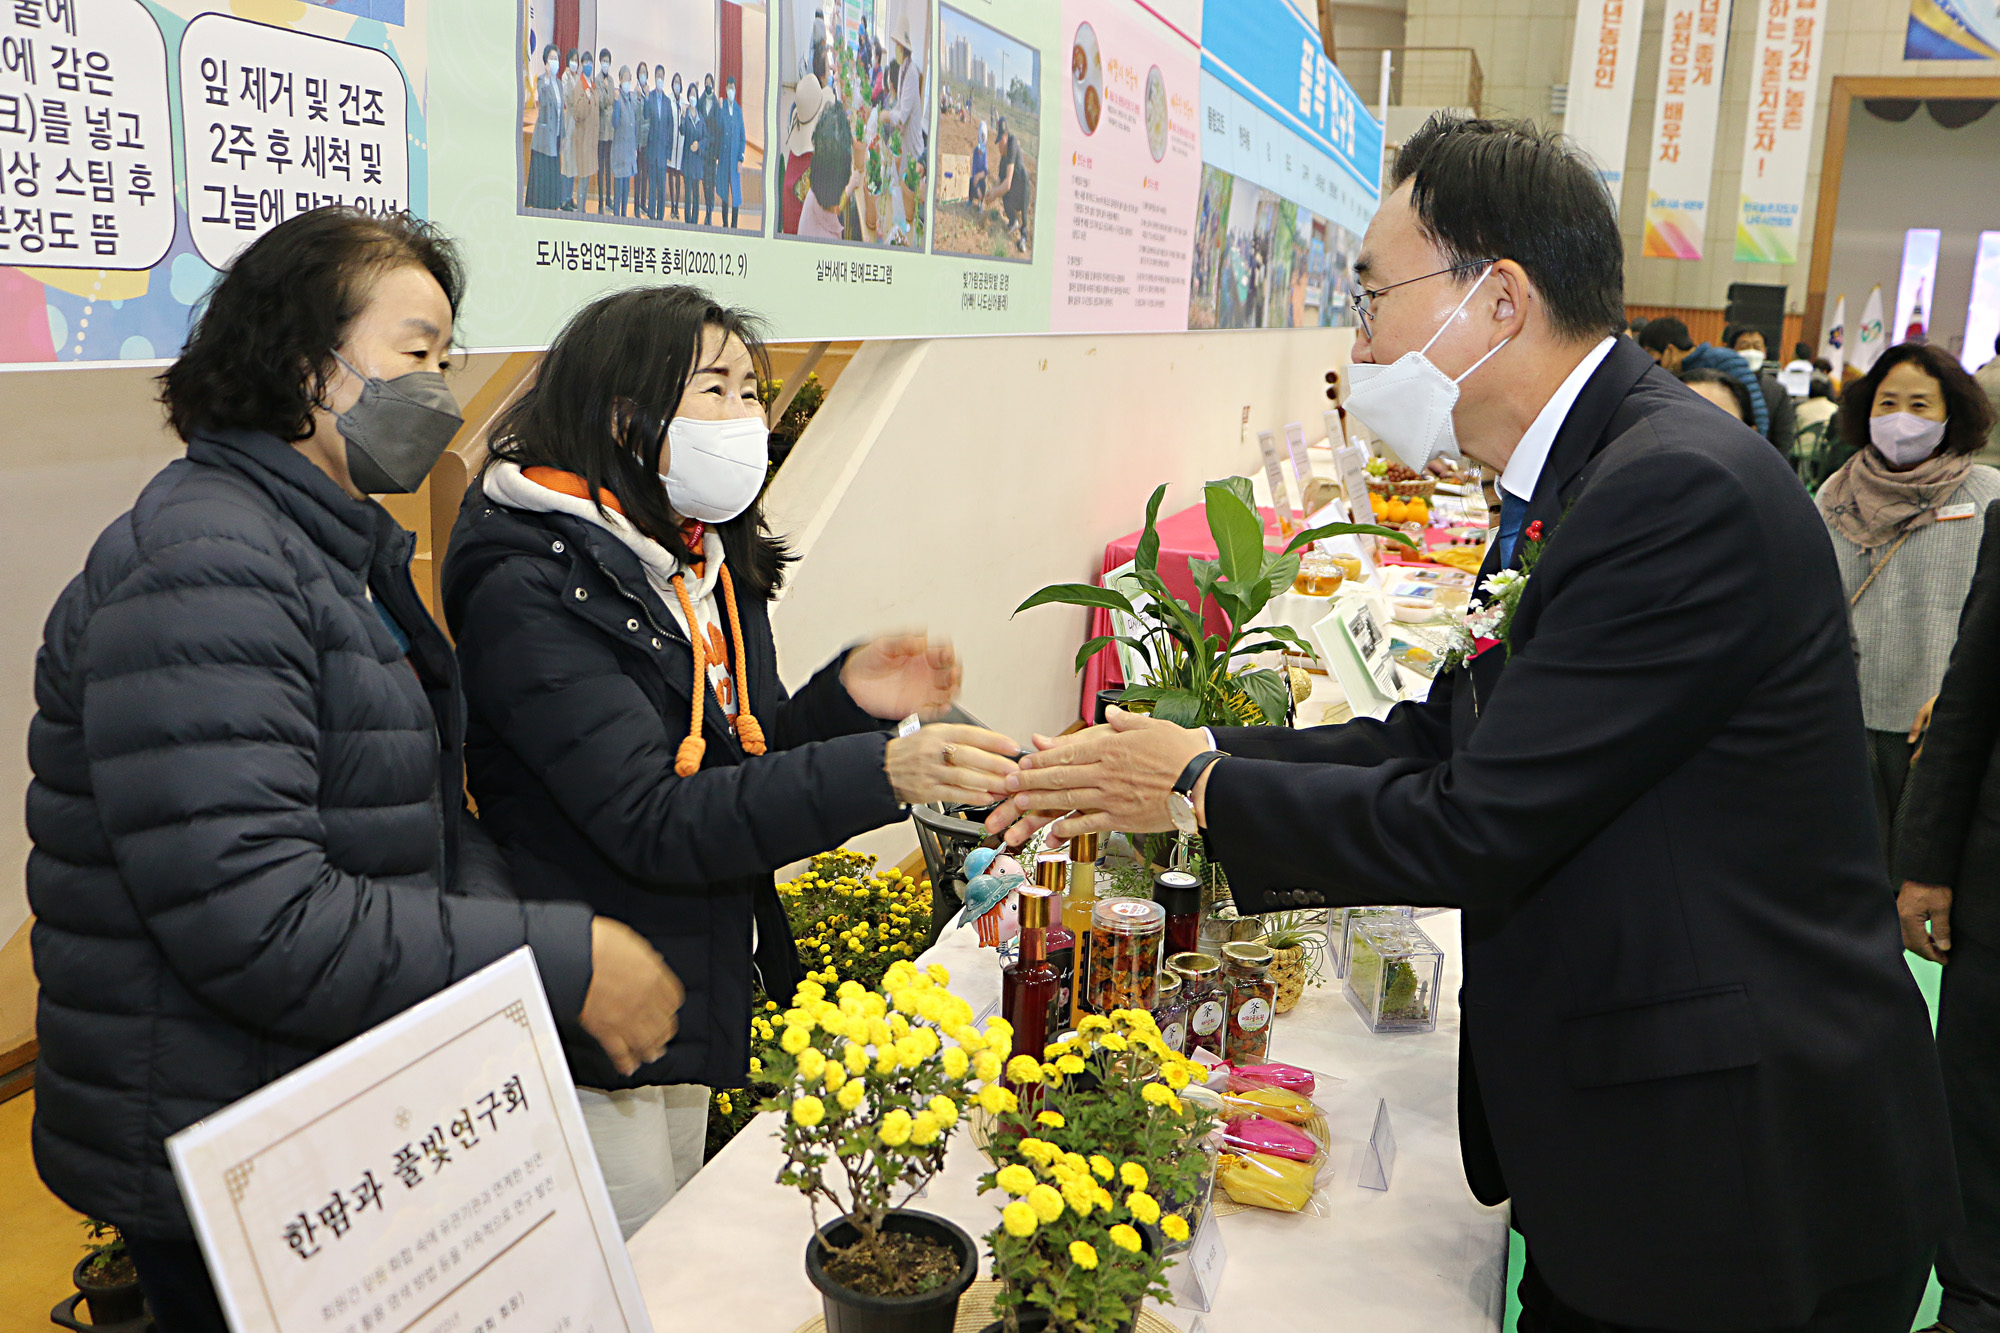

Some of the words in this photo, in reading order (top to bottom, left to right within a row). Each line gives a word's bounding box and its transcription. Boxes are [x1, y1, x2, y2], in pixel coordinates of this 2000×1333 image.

[15, 0, 77, 36] 에
[51, 44, 115, 97] 감은
[201, 57, 229, 107] 잎
[239, 66, 294, 117] 제거
[305, 77, 329, 122] 및
[338, 84, 386, 127] 건조
[84, 105, 146, 150] 넣고
[208, 122, 257, 171] 2주
[266, 128, 293, 174] 후
[300, 135, 351, 182] 세척
[360, 142, 382, 185] 및
[0, 150, 41, 198] 상
[56, 157, 115, 203] 스팀
[128, 163, 156, 206] 후
[202, 185, 285, 230] 그늘에
[90, 213, 119, 255] 뜸
[536, 239, 657, 274] 도시농업연구회발족
[737, 254, 749, 278] 9)
[815, 261, 848, 284] 실버세대
[849, 263, 893, 286] 원예프로그램
[282, 1169, 384, 1261] 한땀과
[392, 1075, 530, 1189] 풀빛연구회
